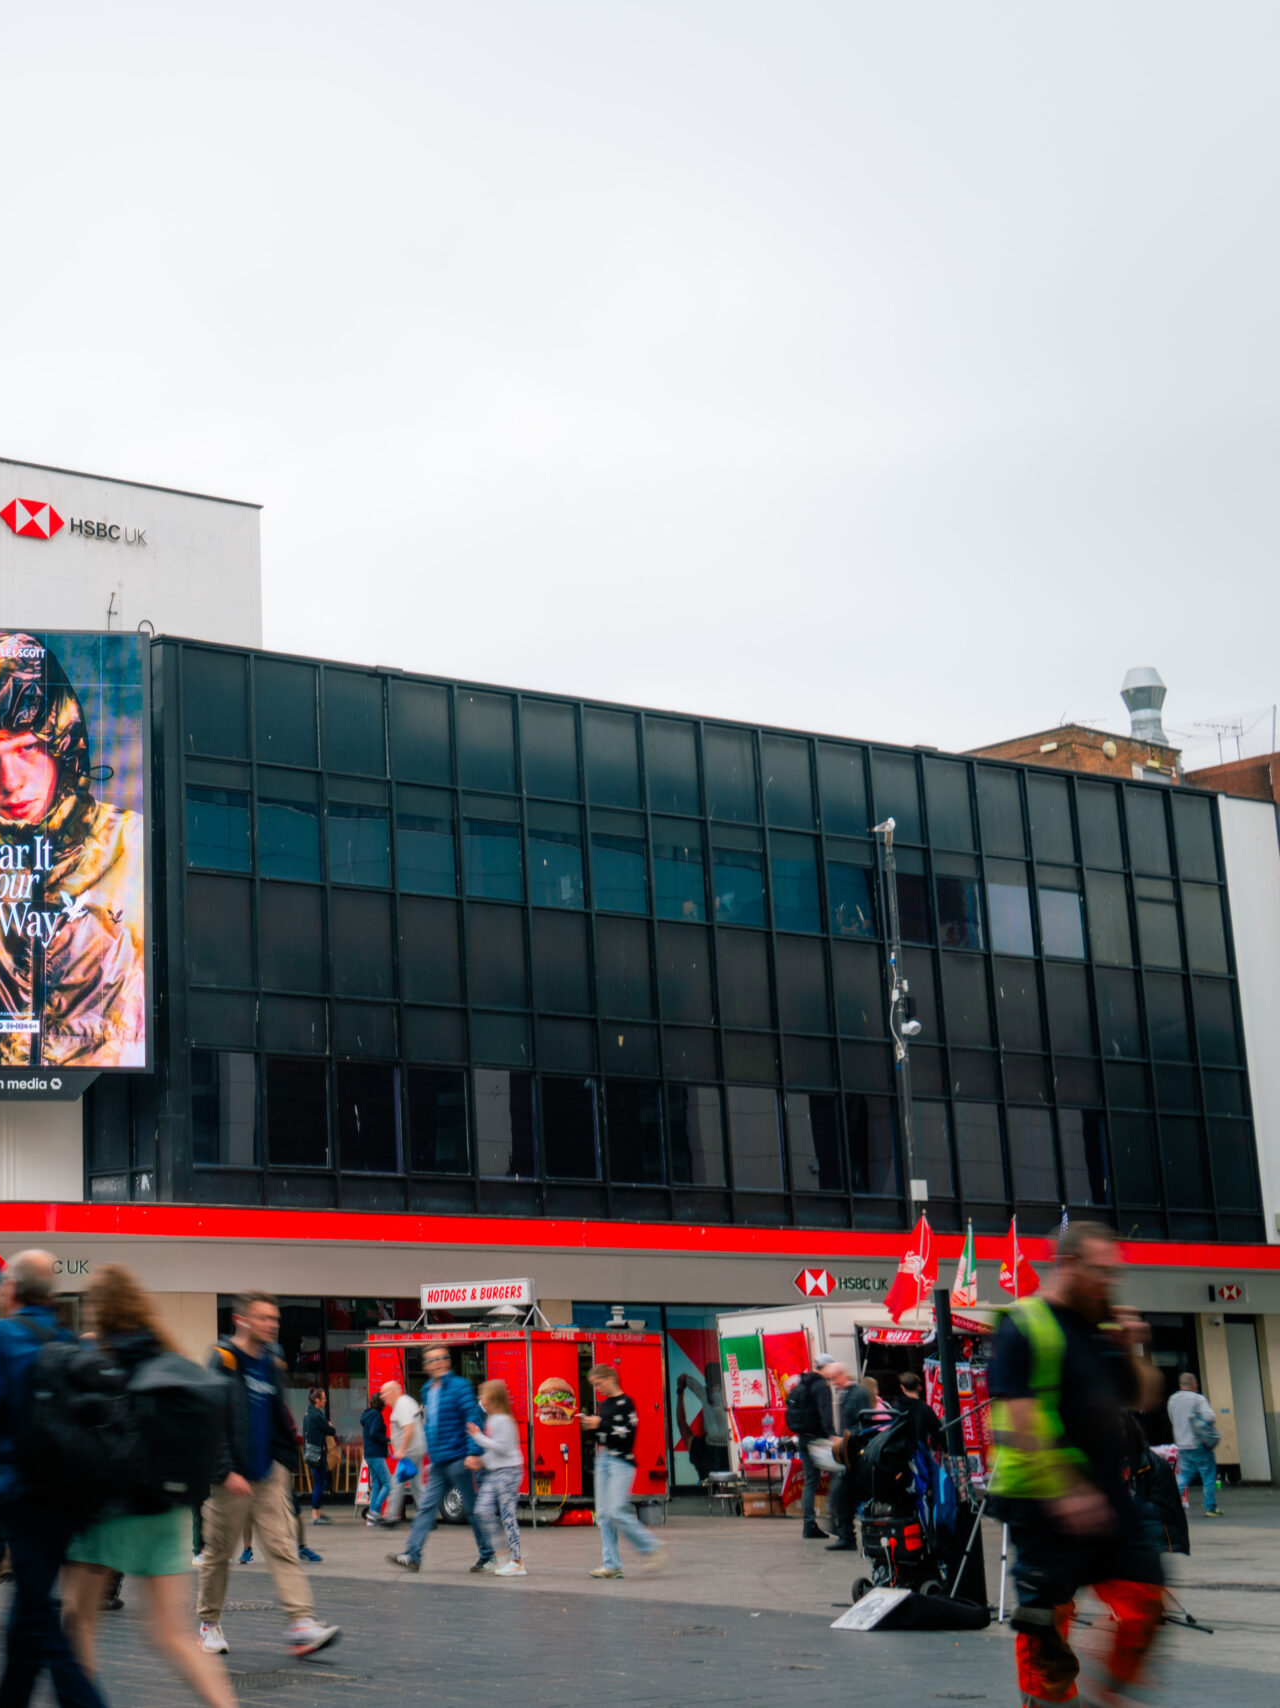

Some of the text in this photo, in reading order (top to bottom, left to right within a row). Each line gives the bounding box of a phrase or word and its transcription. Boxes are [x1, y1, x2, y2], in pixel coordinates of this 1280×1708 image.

[70, 517, 148, 545] HSBC UK
[18, 648, 46, 658] SCOTT
[33, 836, 54, 871] It
[7, 1077, 47, 1090] media
[67, 1260, 89, 1274] UK
[839, 1277, 888, 1291] HSBC UK
[427, 1284, 523, 1303] HOTDOGS & BURGERS
[550, 1331, 575, 1340] COFFEE
[585, 1332, 597, 1341] TEA
[606, 1333, 623, 1342] COLD
[886, 1331, 912, 1342] WIRTZ
[727, 1354, 740, 1386] IRISH
[962, 1406, 974, 1441] WIRTZ
